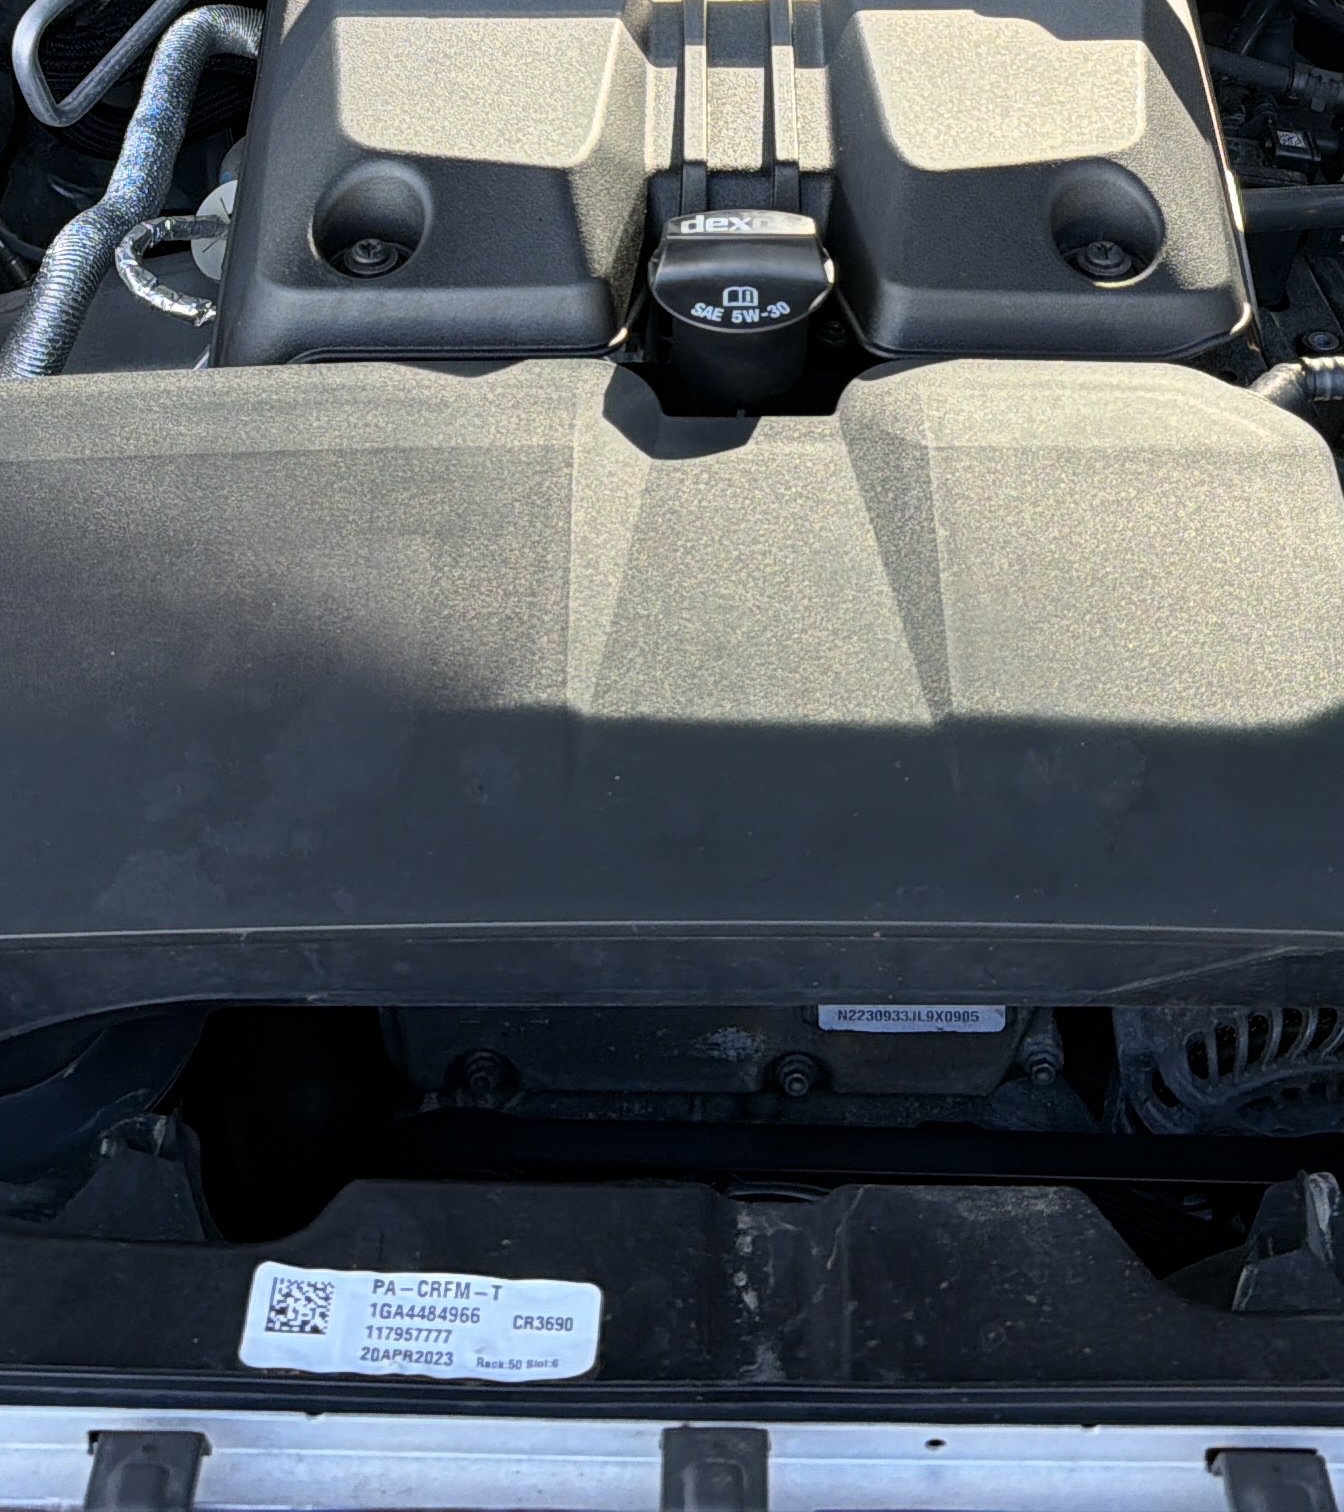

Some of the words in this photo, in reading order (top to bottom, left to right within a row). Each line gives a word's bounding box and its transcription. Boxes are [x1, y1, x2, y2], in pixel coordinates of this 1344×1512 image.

[690, 302, 725, 323] SAE
[731, 301, 791, 324] 5W-30
[369, 1302, 481, 1325] 1GA4484966
[512, 1314, 574, 1333] CR3690
[364, 1325, 453, 1344] 117957777
[360, 1346, 454, 1367] 20APR2023
